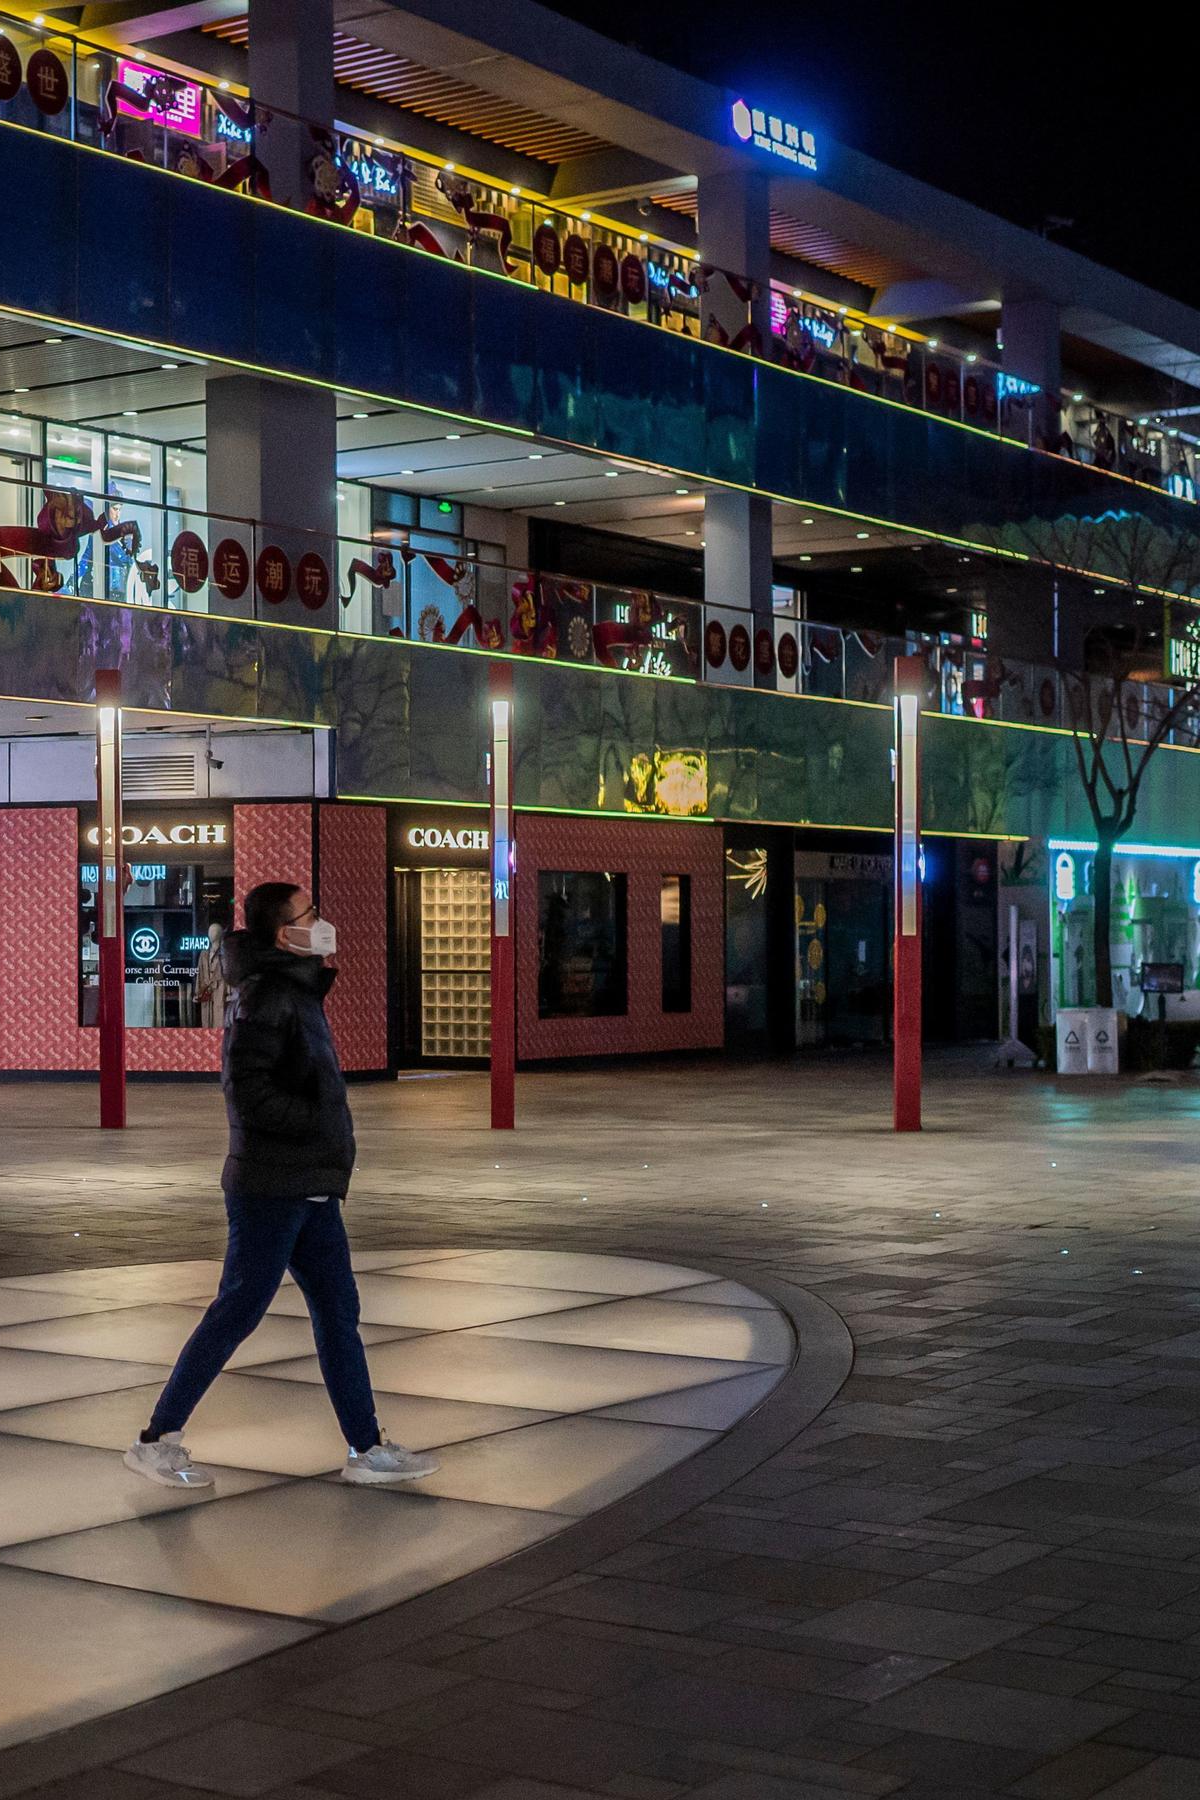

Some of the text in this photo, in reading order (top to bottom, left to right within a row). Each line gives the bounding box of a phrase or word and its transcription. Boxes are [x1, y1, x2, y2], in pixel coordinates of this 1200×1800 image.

[180, 546, 322, 593] 福运潮玩
[87, 824, 227, 845] COACH
[408, 827, 489, 849] COACH
[144, 964, 161, 974] and
[135, 976, 180, 987] Collection
